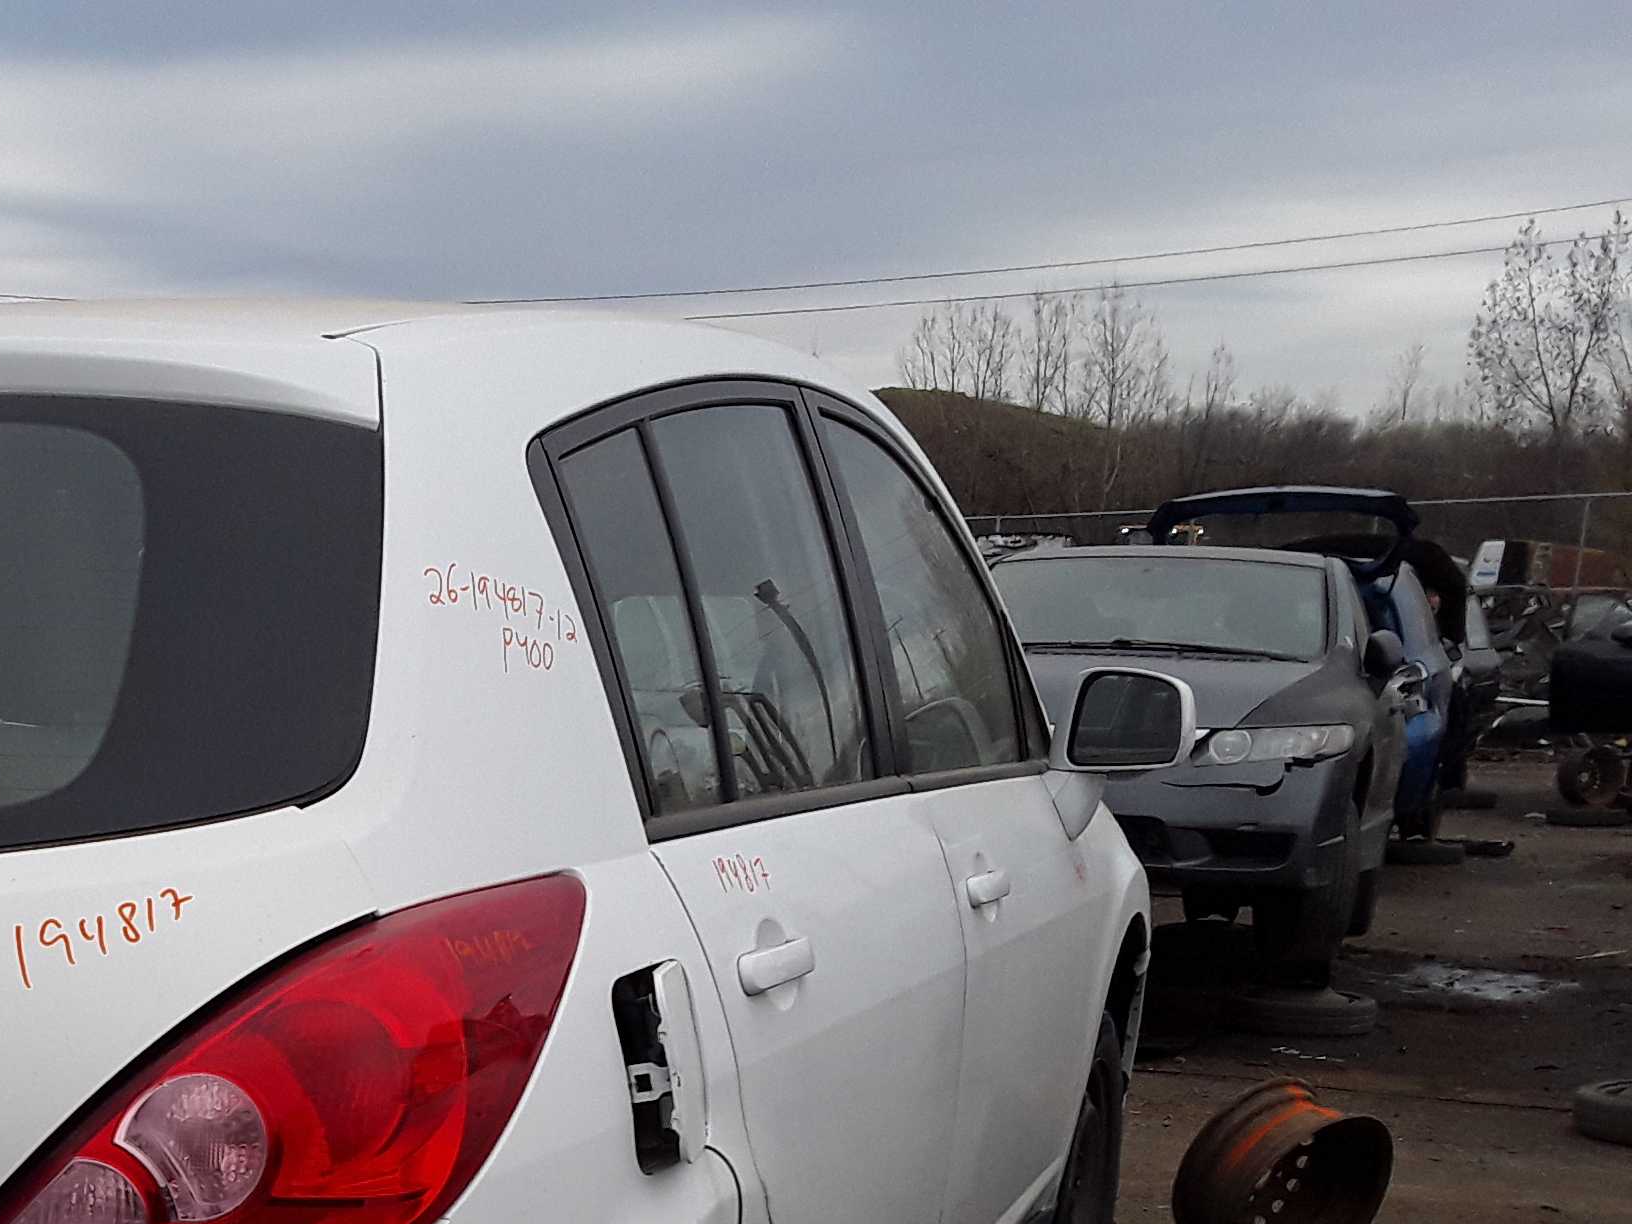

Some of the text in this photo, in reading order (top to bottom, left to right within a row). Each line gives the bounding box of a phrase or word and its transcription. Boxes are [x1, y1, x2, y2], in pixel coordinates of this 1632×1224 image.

[502, 627, 554, 673] P400
[712, 854, 770, 893] 194817
[15, 888, 193, 988] 194817
